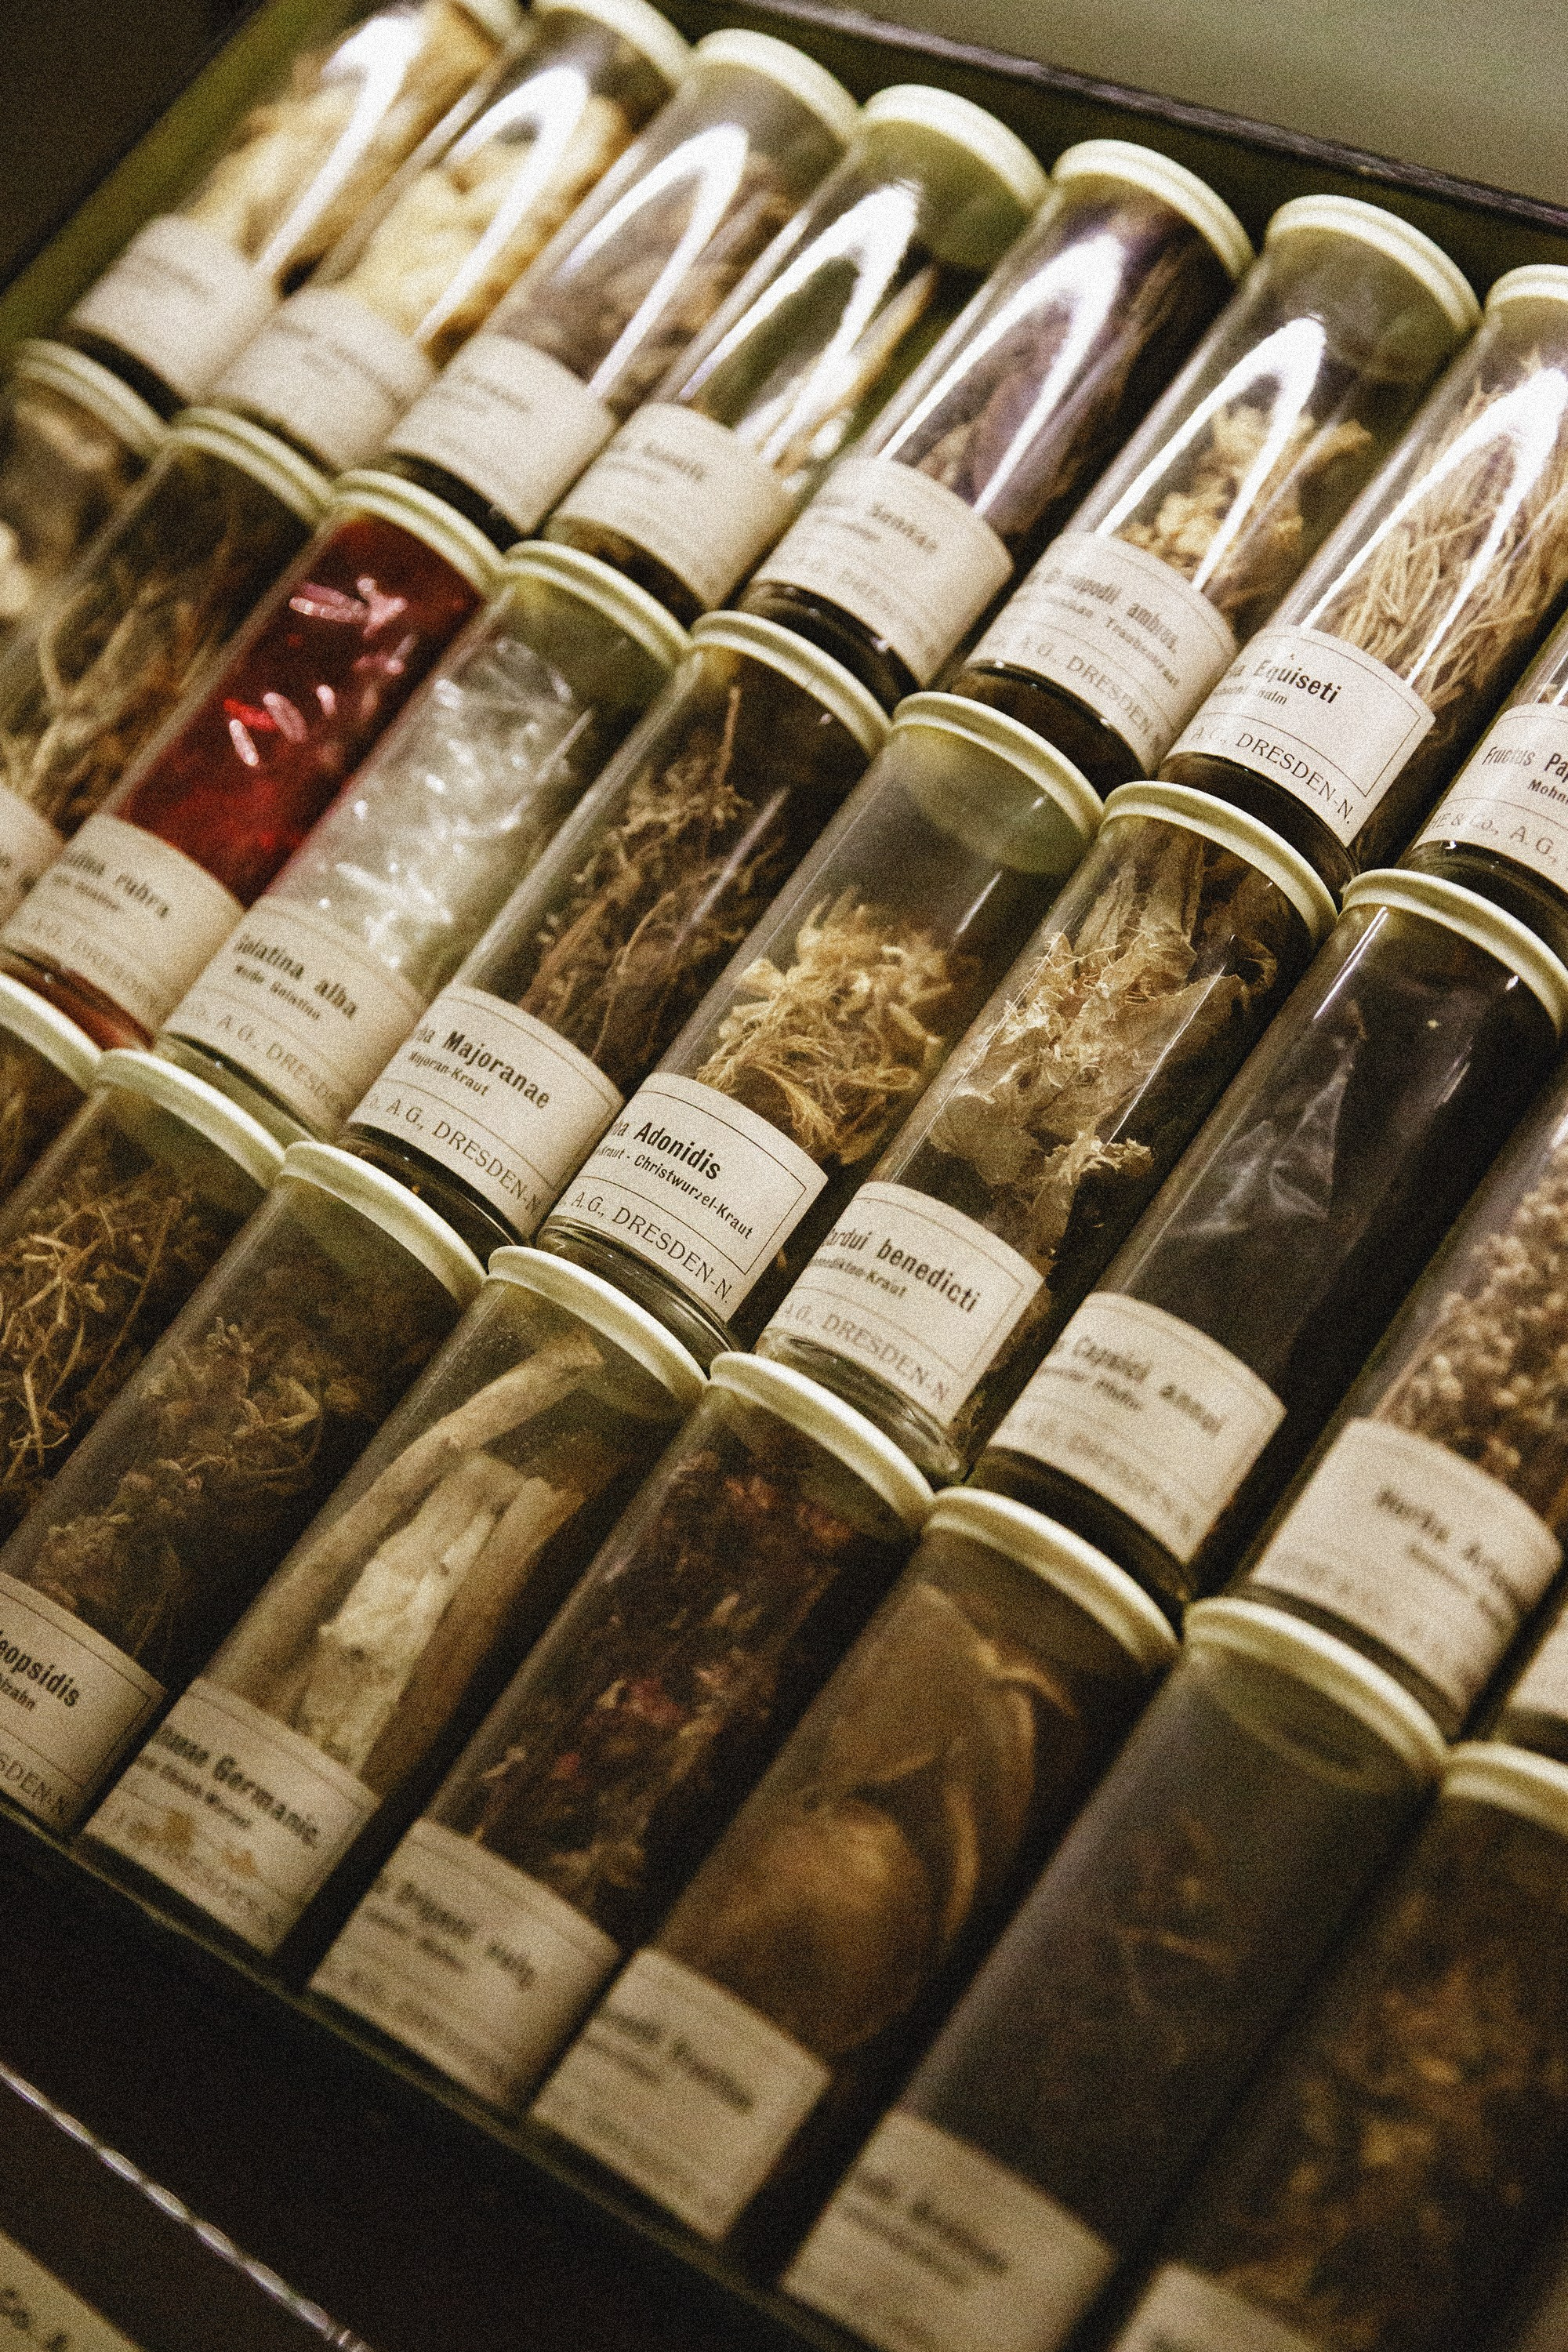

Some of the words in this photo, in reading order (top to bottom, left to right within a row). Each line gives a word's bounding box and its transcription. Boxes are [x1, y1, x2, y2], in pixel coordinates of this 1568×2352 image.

[1253, 659, 1341, 705] Equiseti
[442, 1029, 550, 1109] Majoranae
[633, 1121, 721, 1181] Adonidis
[877, 1237, 982, 1314] benedicti
